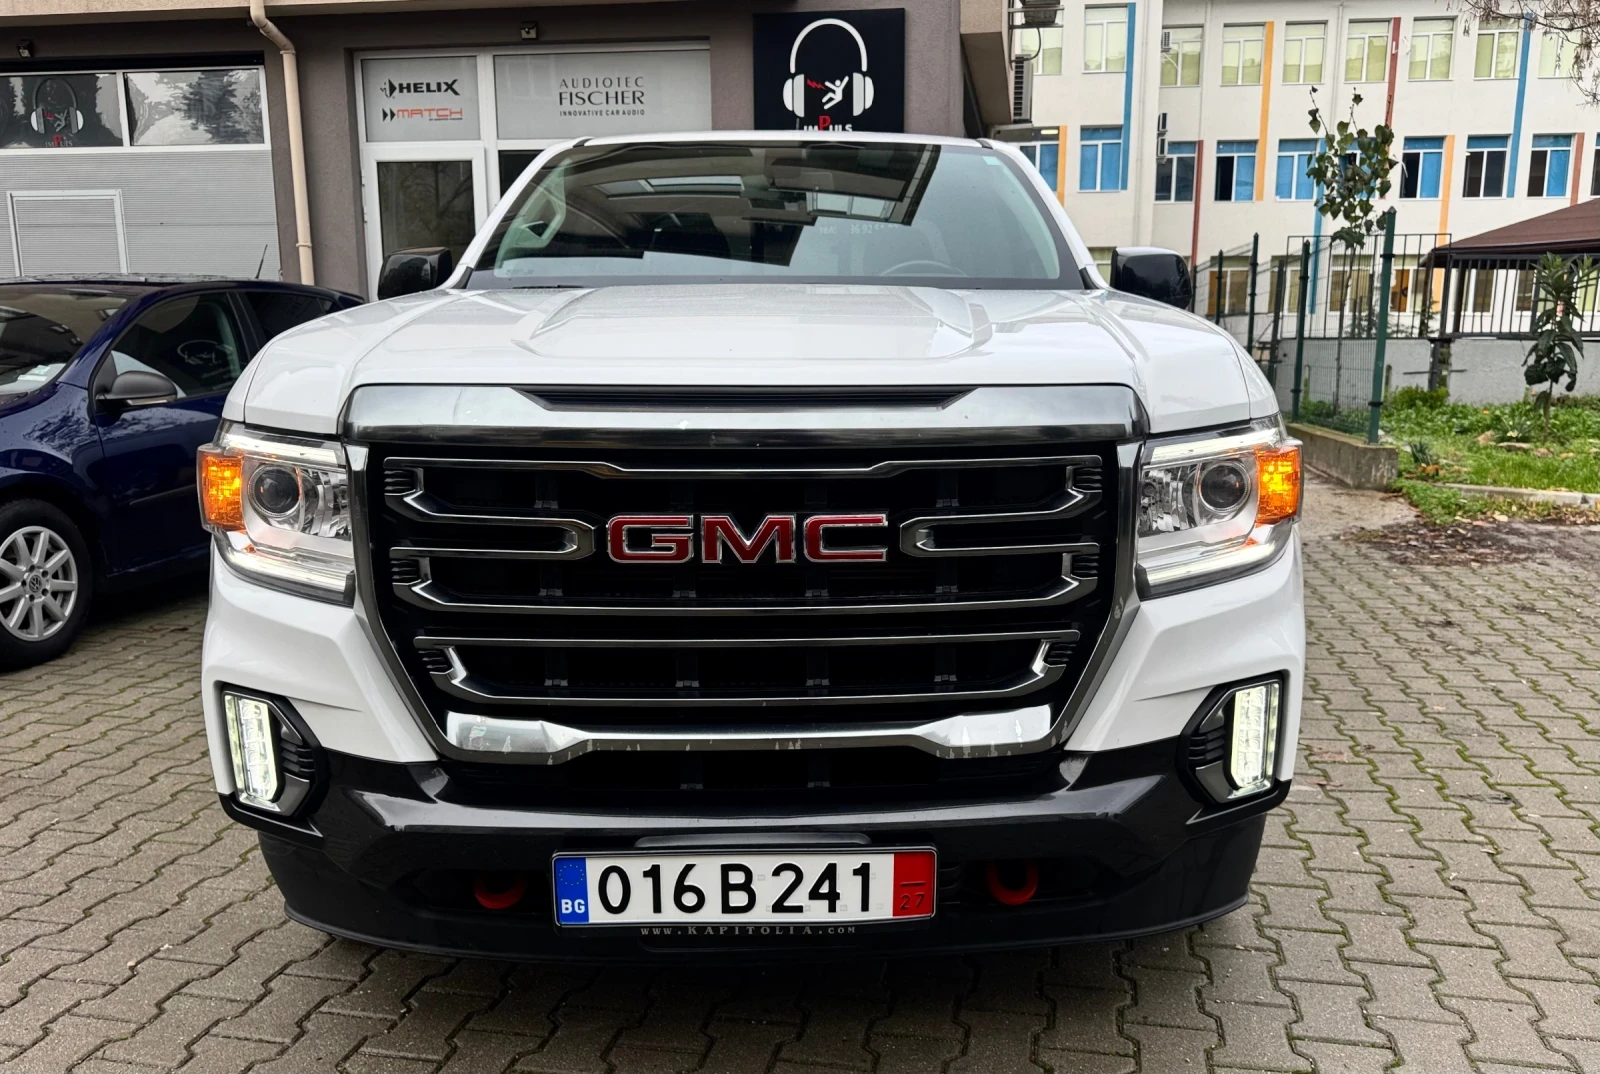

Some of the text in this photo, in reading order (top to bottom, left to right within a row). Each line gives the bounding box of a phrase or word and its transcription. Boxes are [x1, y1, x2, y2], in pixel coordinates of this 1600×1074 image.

[398, 79, 461, 96] HELIX
[560, 76, 644, 89] AUDIOTEC
[559, 90, 645, 106] FISCHER
[397, 108, 463, 118] MATCH
[560, 109, 603, 117] INNOVATIVE
[605, 109, 620, 117] CAR
[606, 514, 888, 564] GMC
[561, 899, 586, 914] BG
[900, 892, 925, 910] 27
